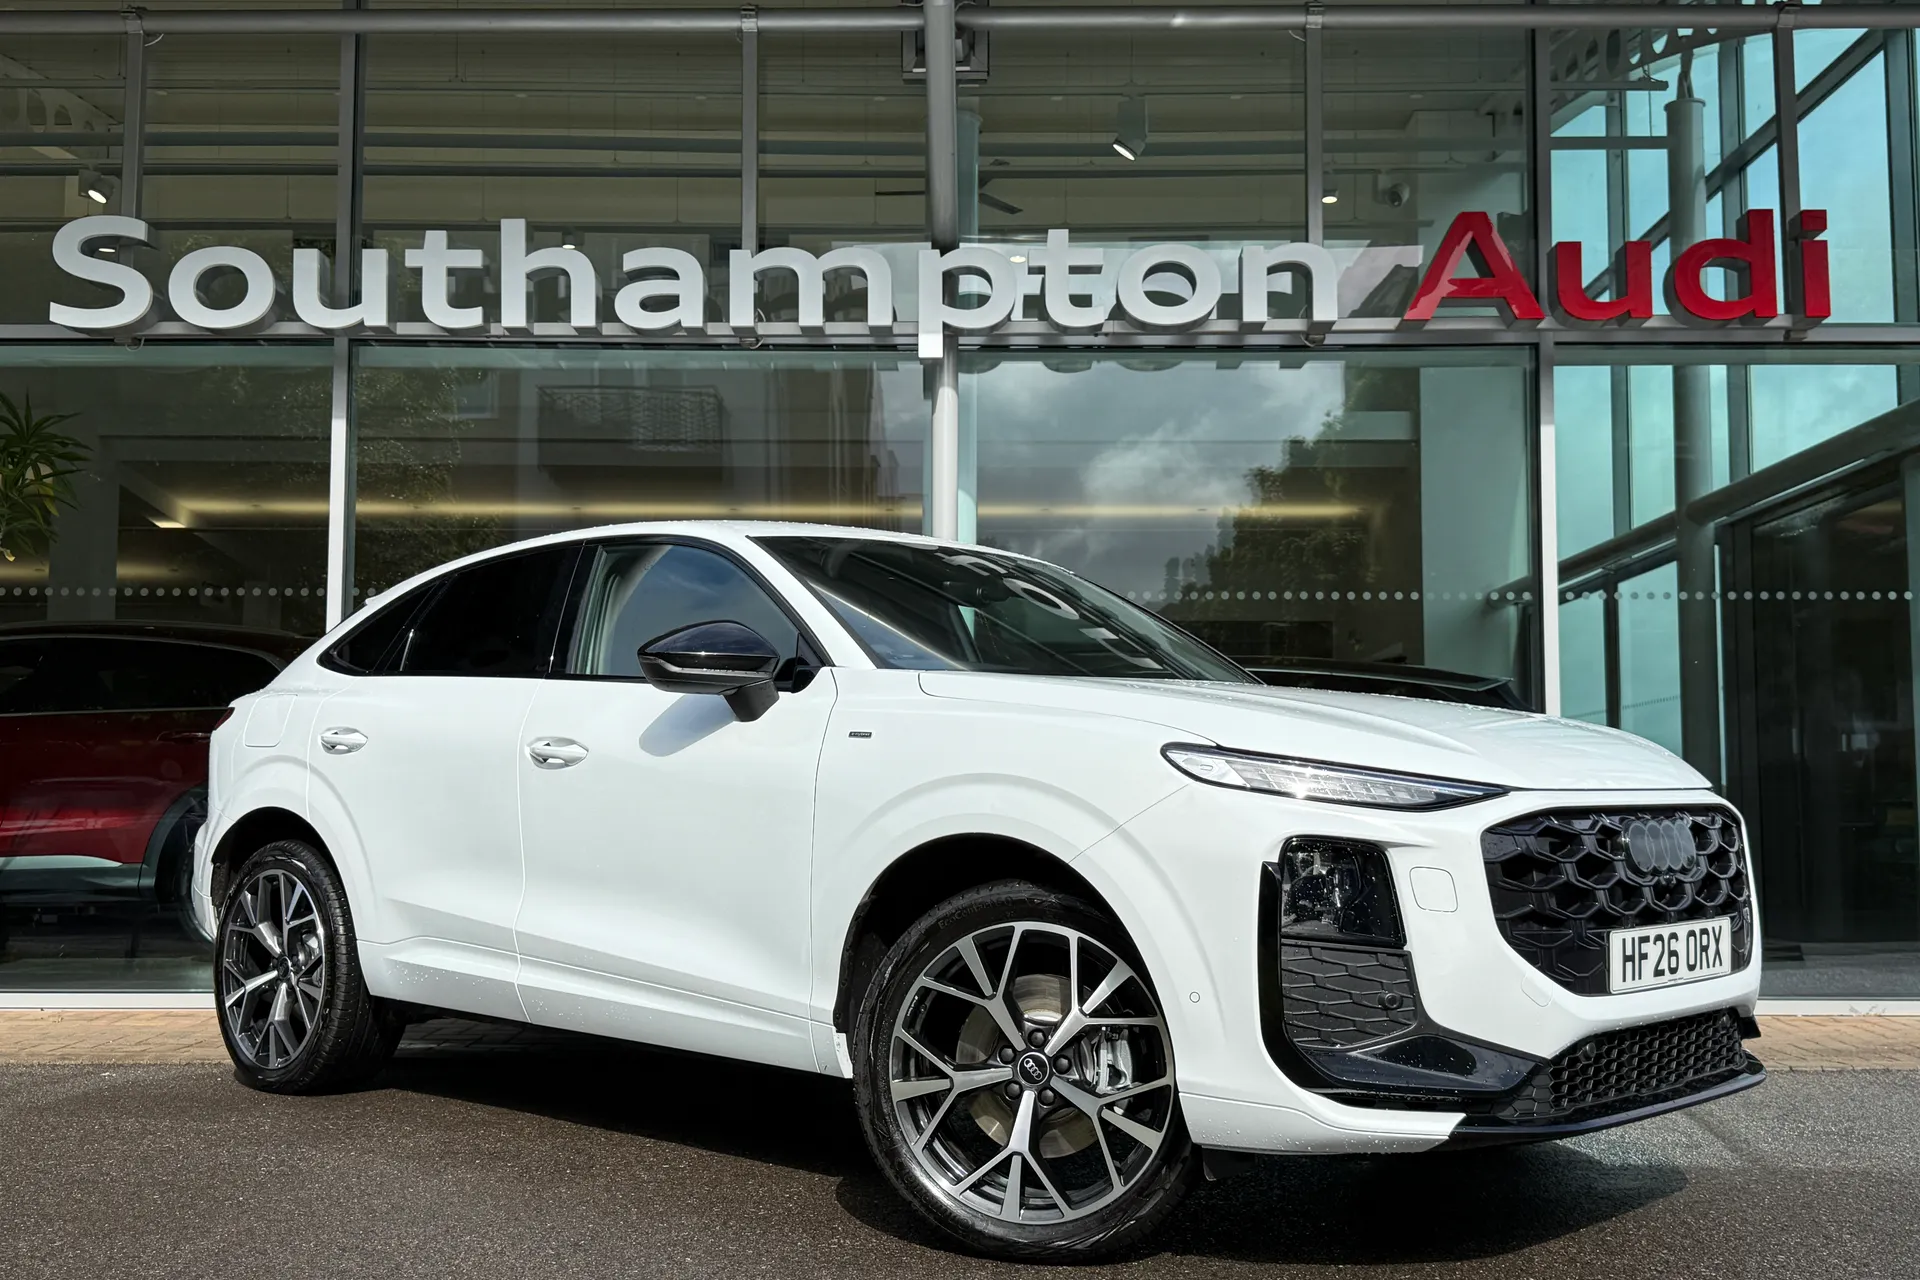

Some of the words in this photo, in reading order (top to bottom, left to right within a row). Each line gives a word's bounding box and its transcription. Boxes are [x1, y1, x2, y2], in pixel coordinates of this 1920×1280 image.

[49, 214, 1340, 358] Southampton
[1402, 208, 1832, 323] Audi
[1622, 932, 1679, 982] HF26
[1686, 925, 1723, 972] ORX
